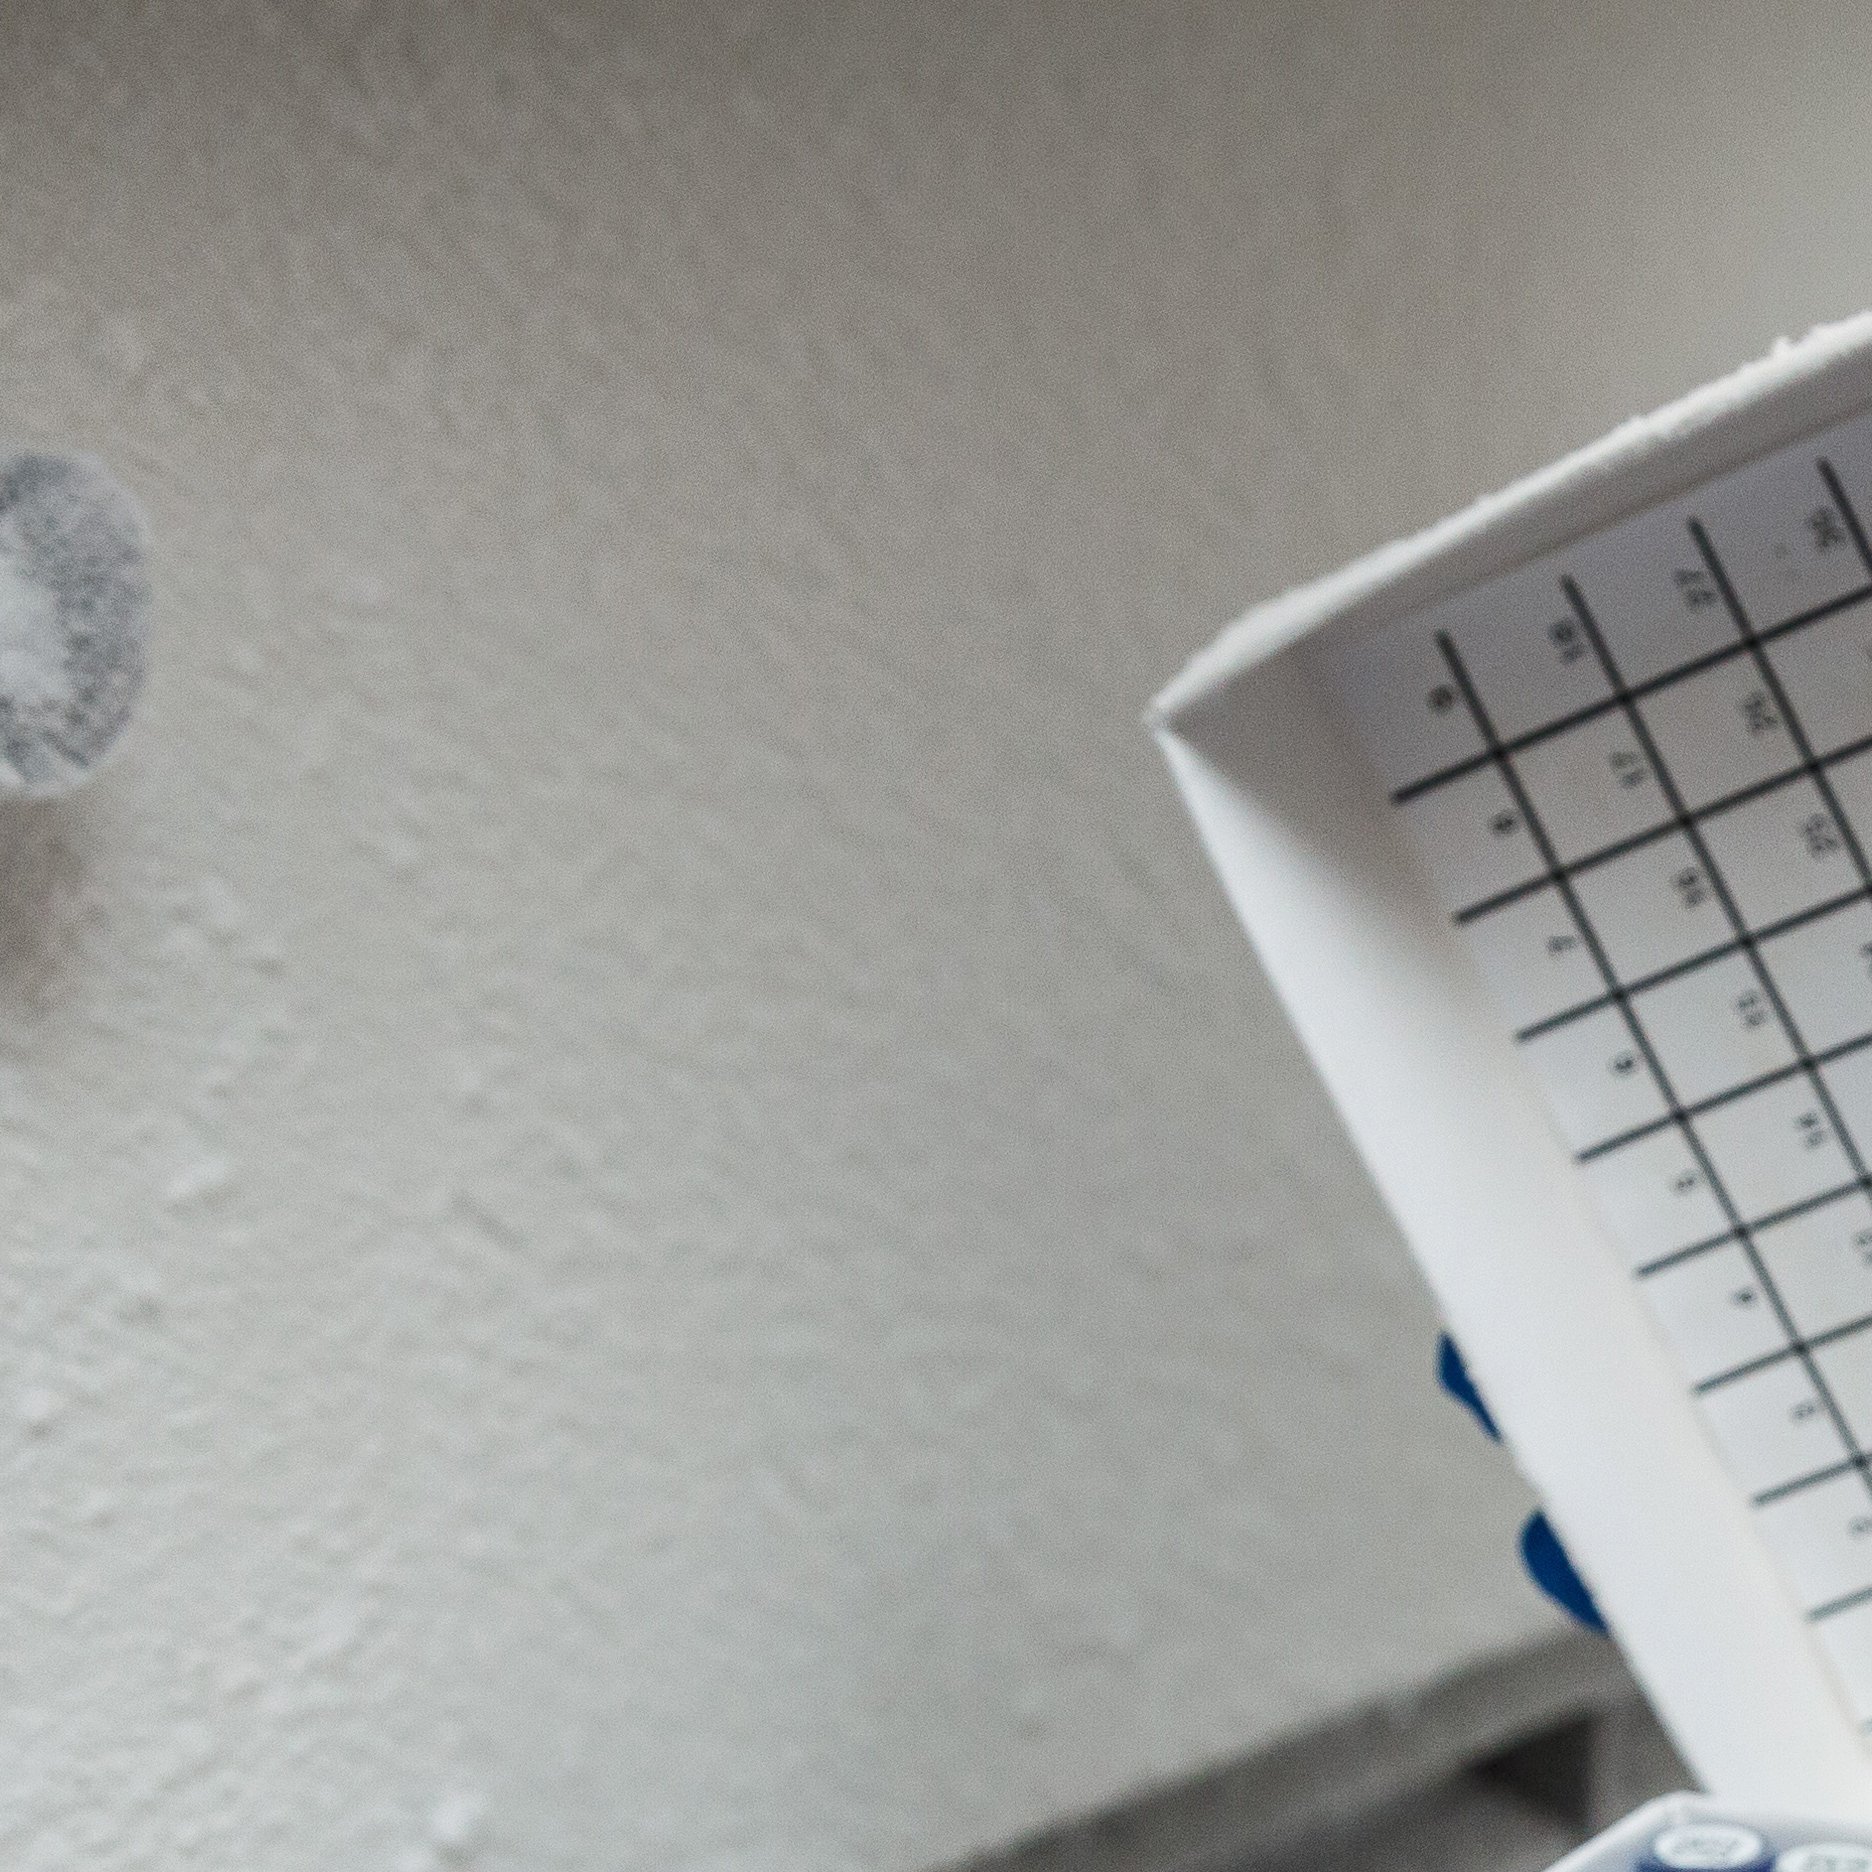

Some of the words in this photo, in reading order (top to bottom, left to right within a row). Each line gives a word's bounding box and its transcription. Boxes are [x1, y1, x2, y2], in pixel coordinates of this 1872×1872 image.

[1804, 505, 1848, 554] 36
[1671, 567, 1720, 613] 27
[1546, 616, 1587, 666] 18
[1738, 689, 1781, 738] 26
[1606, 749, 1650, 791] 17
[1798, 811, 1843, 860] 25
[1671, 865, 1710, 910] 16
[1544, 933, 1580, 958] 7
[1733, 987, 1770, 1031] 15
[1793, 1109, 1829, 1151] 14
[1727, 1282, 1762, 1311] 4
